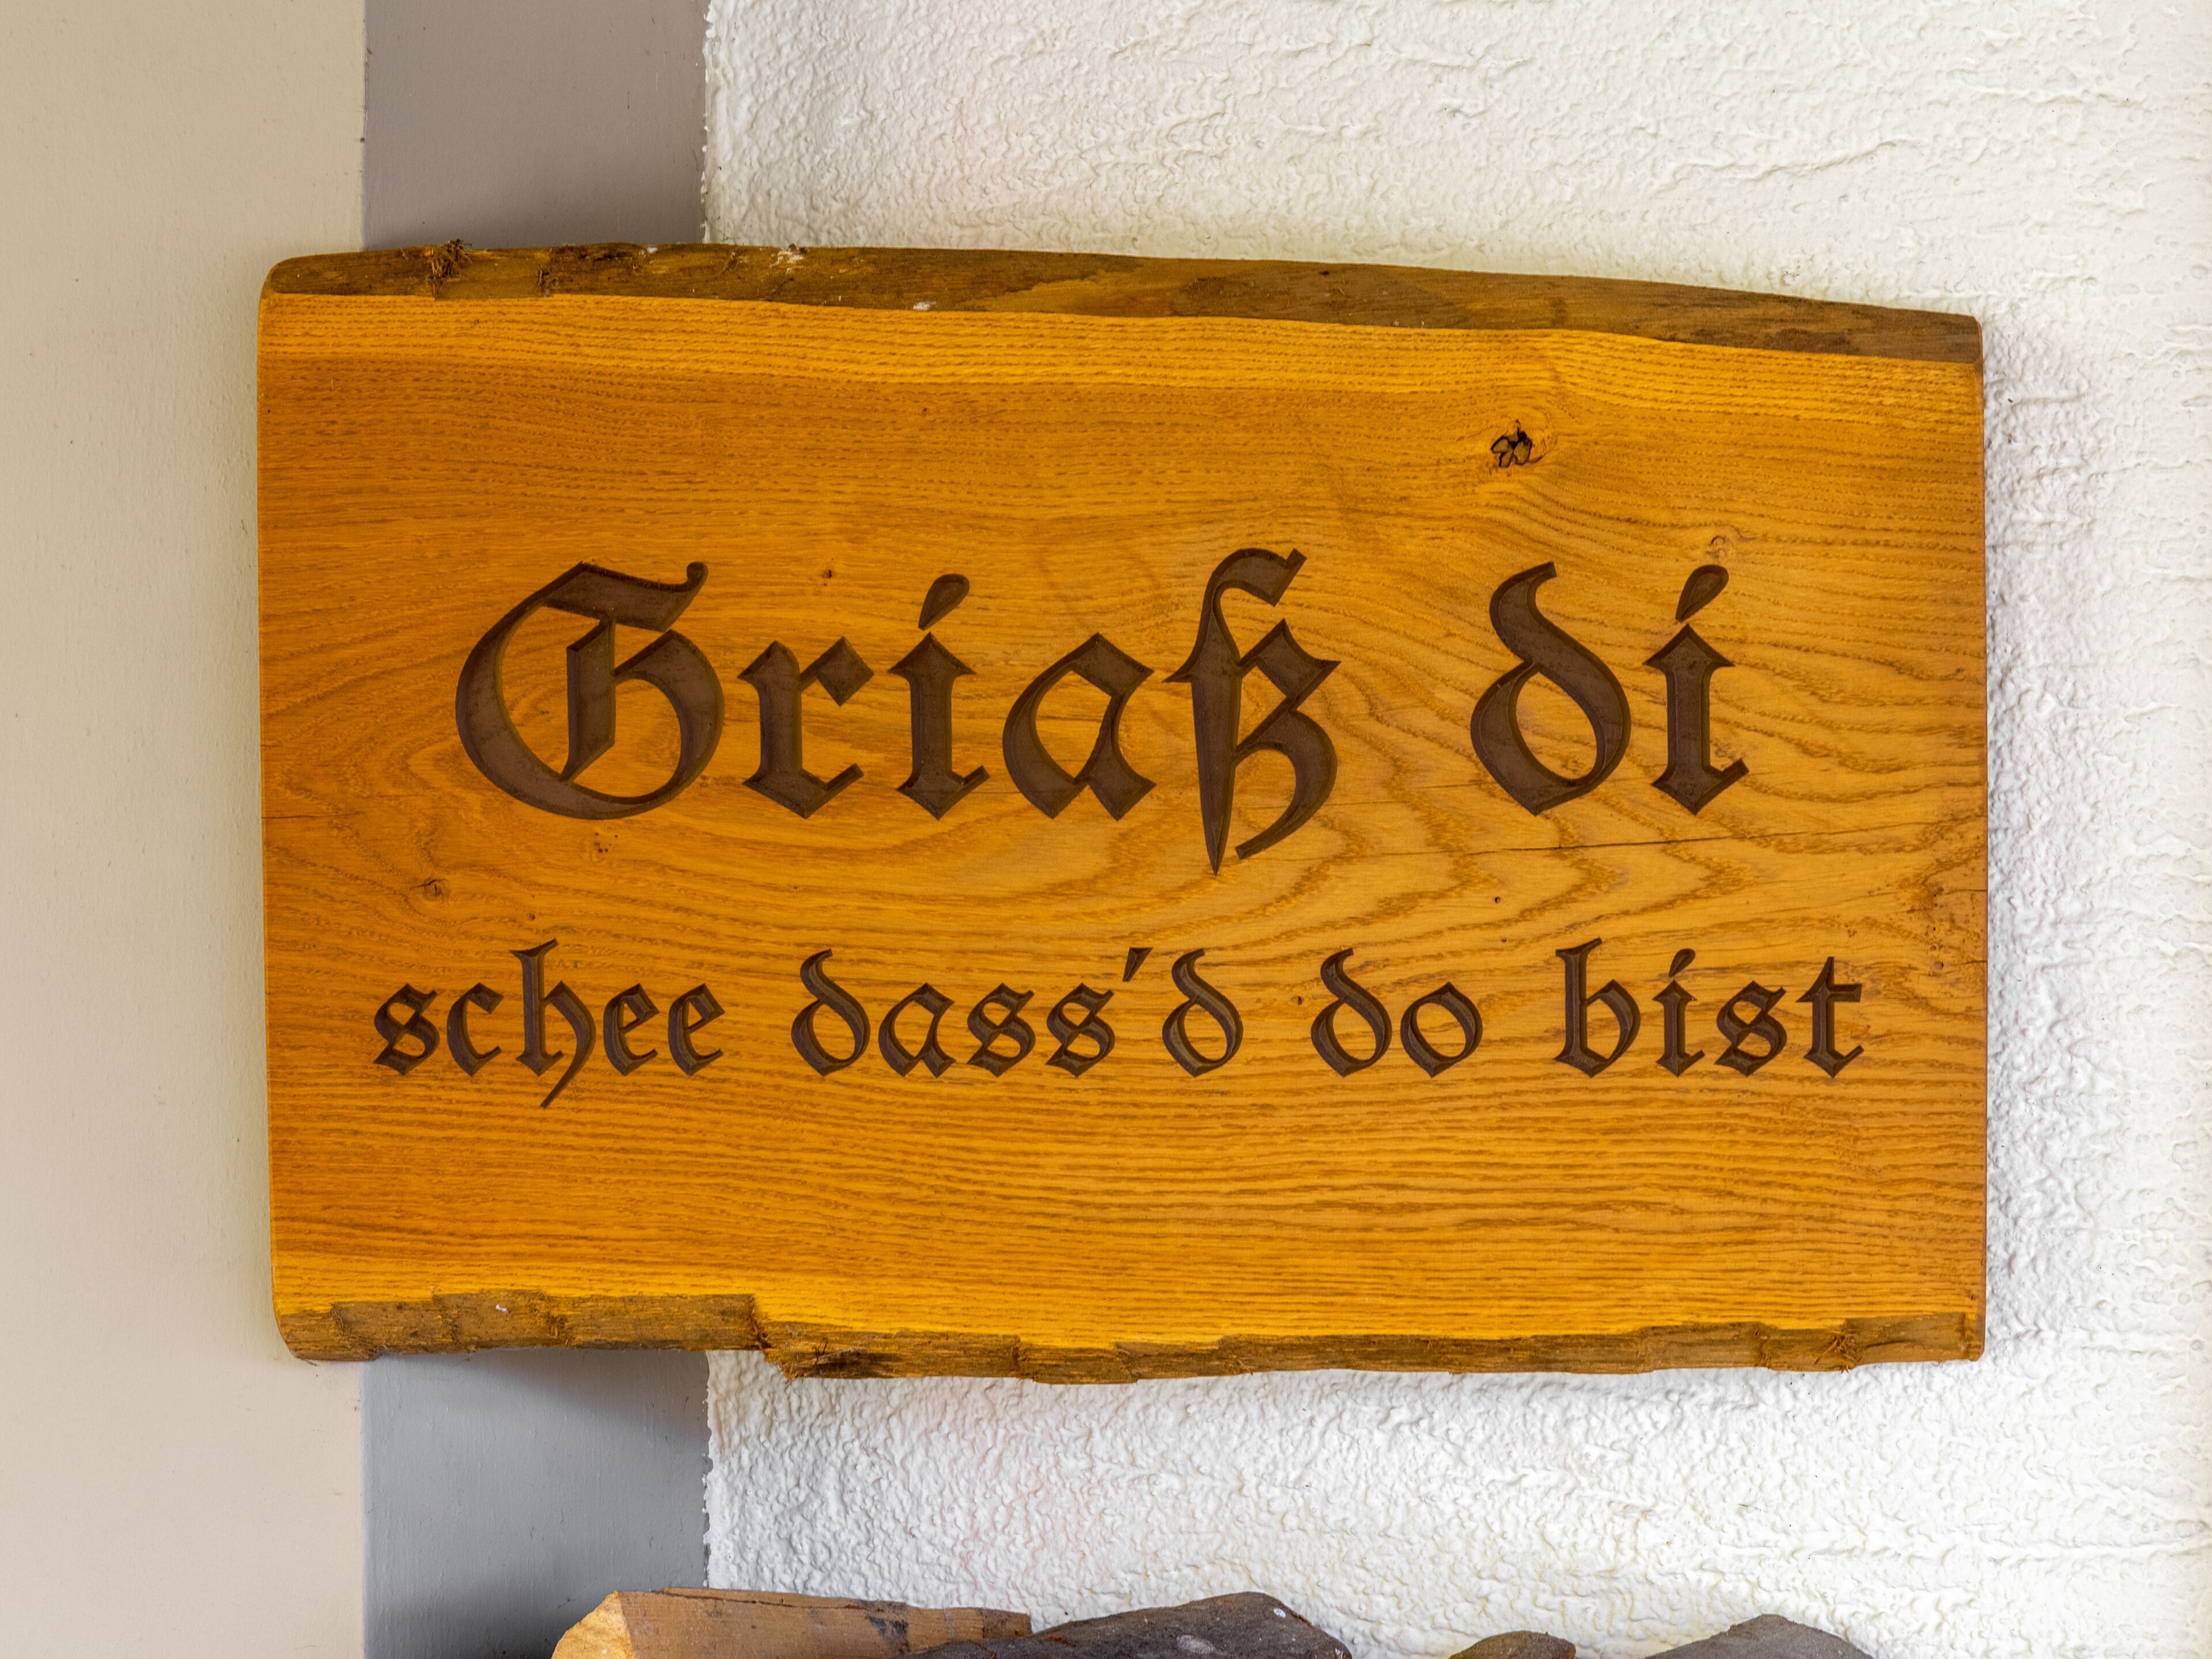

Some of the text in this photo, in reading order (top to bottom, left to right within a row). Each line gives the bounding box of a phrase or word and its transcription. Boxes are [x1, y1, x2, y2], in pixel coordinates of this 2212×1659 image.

[456, 548, 1749, 876] Griaß di
[373, 938, 725, 1109] schee
[1311, 948, 1482, 1078] do
[1554, 938, 1864, 1079] bist
